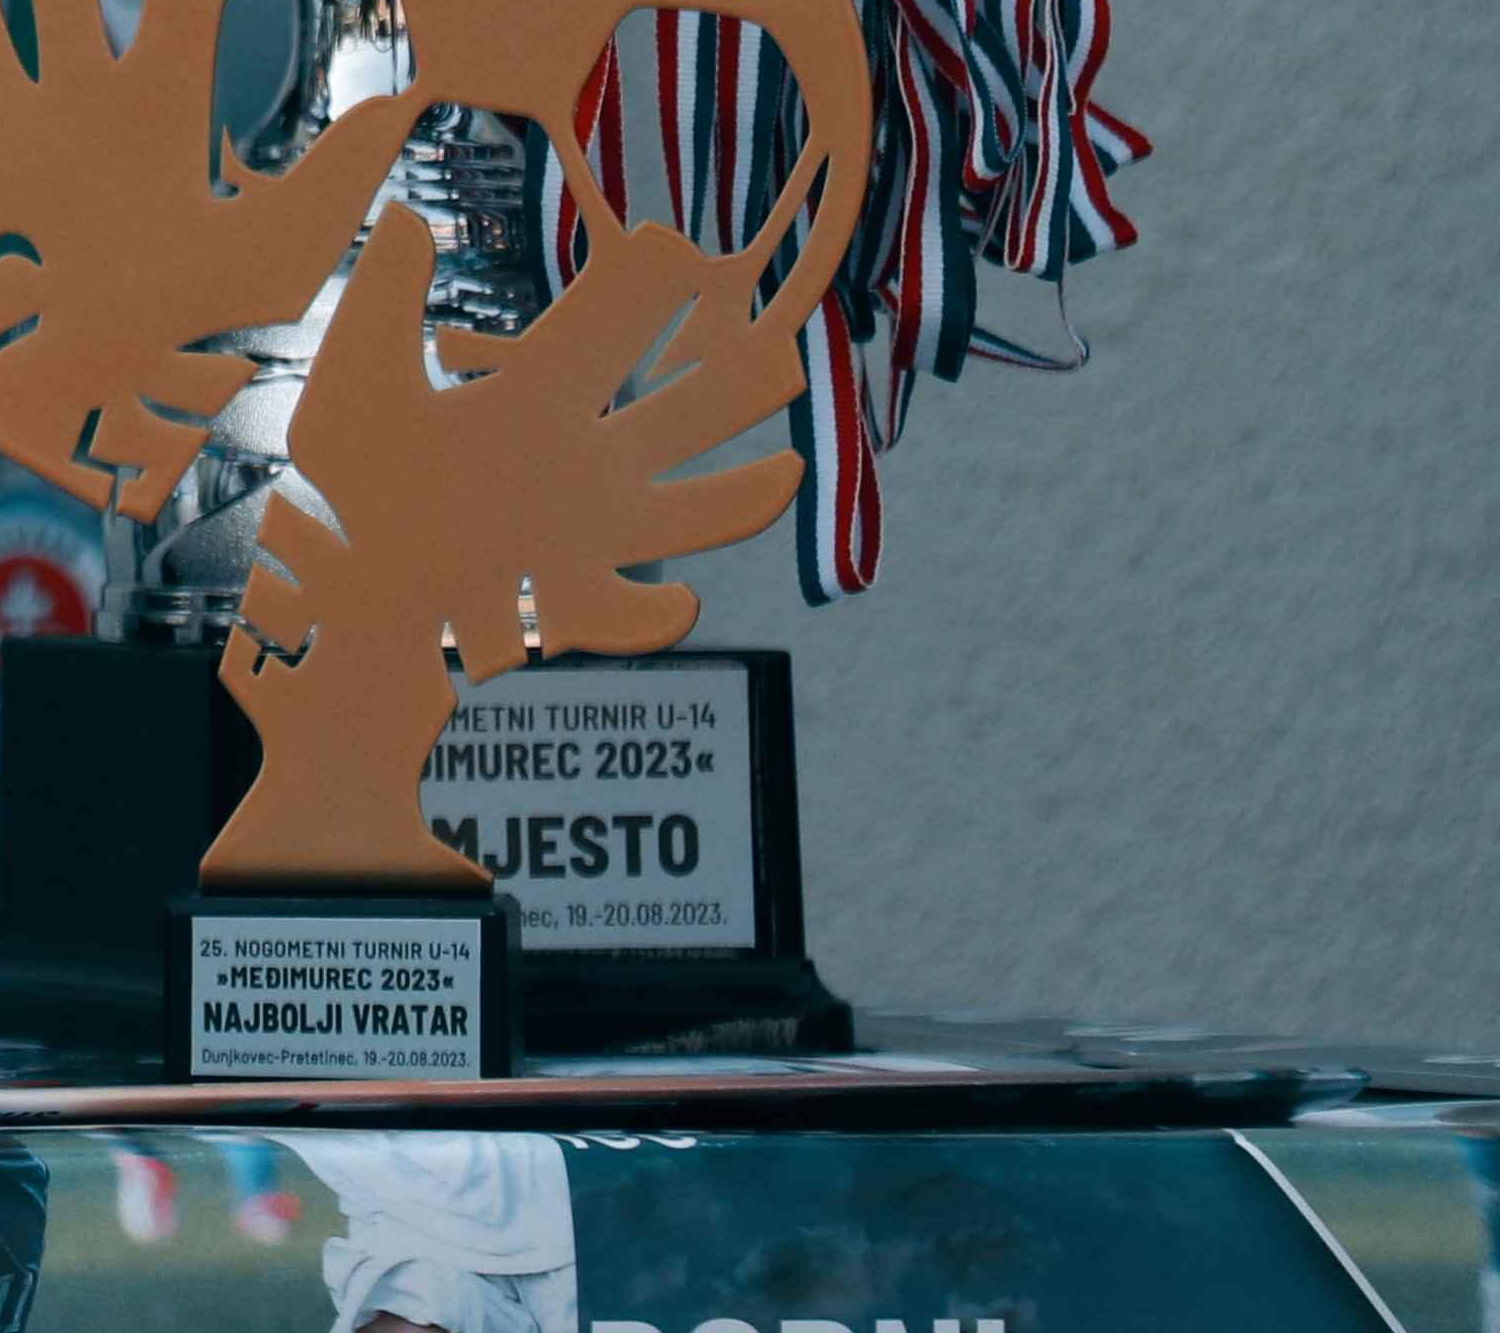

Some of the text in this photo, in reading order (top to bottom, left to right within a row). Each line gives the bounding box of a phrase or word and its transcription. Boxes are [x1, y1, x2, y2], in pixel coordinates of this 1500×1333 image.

[450, 702, 716, 733] METNI TURNIR U-14
[595, 740, 715, 780] 2023«
[567, 901, 728, 928] 19.-20.08.2023.
[200, 939, 470, 961] 25. NOGOMETNI TURNIR U-14
[203, 1002, 468, 1037] NAJBOLJI VRATAR
[363, 1051, 471, 1068] 19.-20.08.2023.
